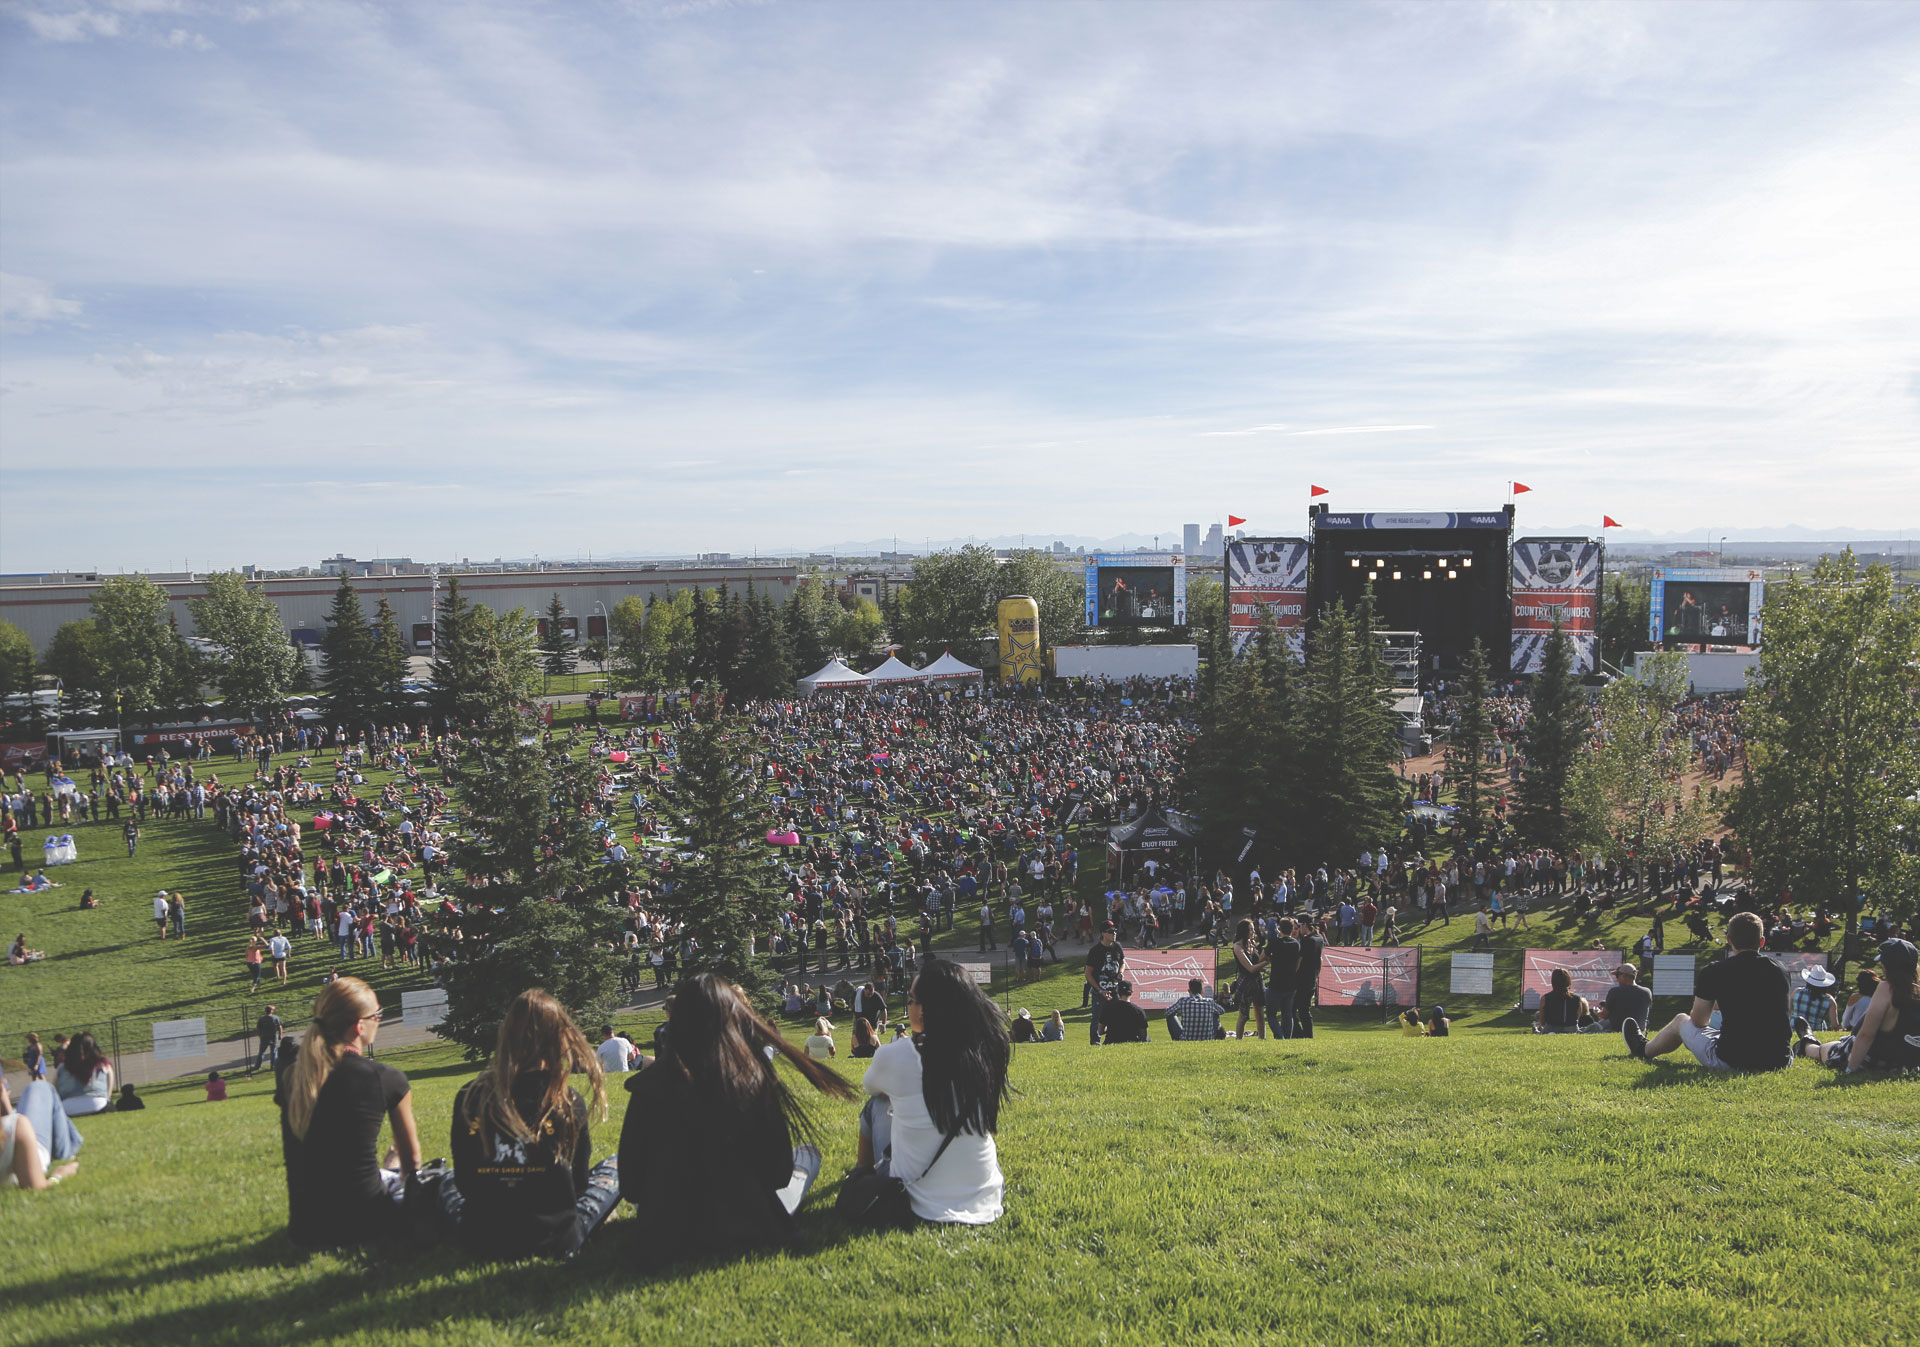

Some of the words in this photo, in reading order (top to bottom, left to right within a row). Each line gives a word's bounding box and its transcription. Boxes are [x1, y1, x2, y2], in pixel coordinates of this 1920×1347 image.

[1331, 517, 1351, 525] AMA
[1476, 516, 1496, 524] AMA
[1250, 575, 1285, 585] CASINO
[1270, 604, 1302, 616] THUNDER
[1515, 605, 1549, 617] COUNTRY
[159, 728, 237, 741] RESTROOMS
